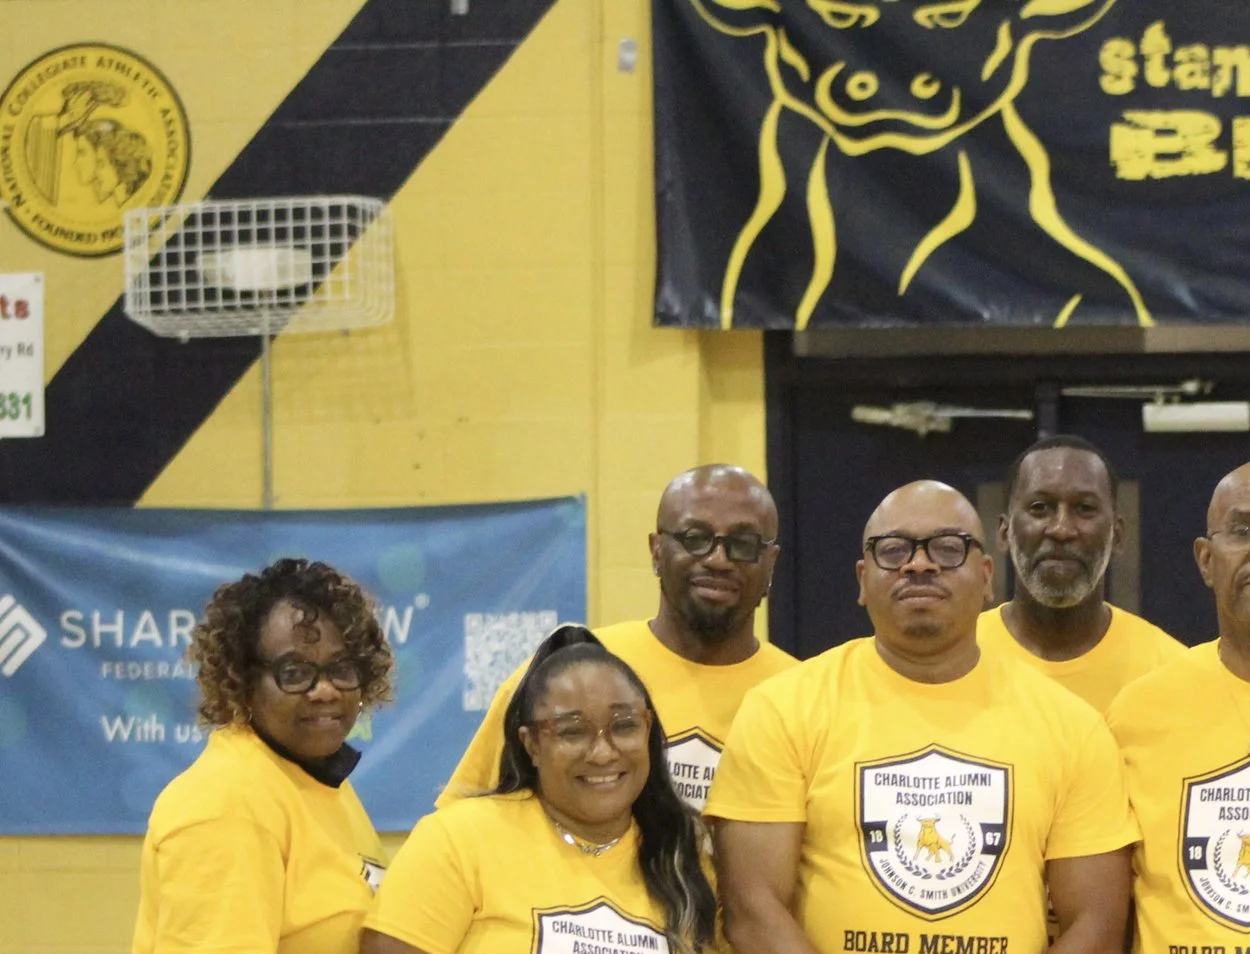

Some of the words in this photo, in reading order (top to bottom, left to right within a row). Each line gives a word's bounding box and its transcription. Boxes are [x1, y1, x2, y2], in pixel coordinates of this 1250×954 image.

[17, 341, 34, 357] Rd
[101, 713, 165, 742] With
[874, 773, 940, 789] CHARLOTTE
[945, 773, 991, 788] ALUMNI
[896, 791, 973, 807] ASSOCIATION
[869, 830, 883, 843] 18
[985, 832, 1001, 846] 67
[1188, 846, 1202, 860] 18
[552, 920, 614, 943] CHARLOTTE
[617, 932, 658, 950] ALUMNI
[844, 930, 909, 954] BOARD
